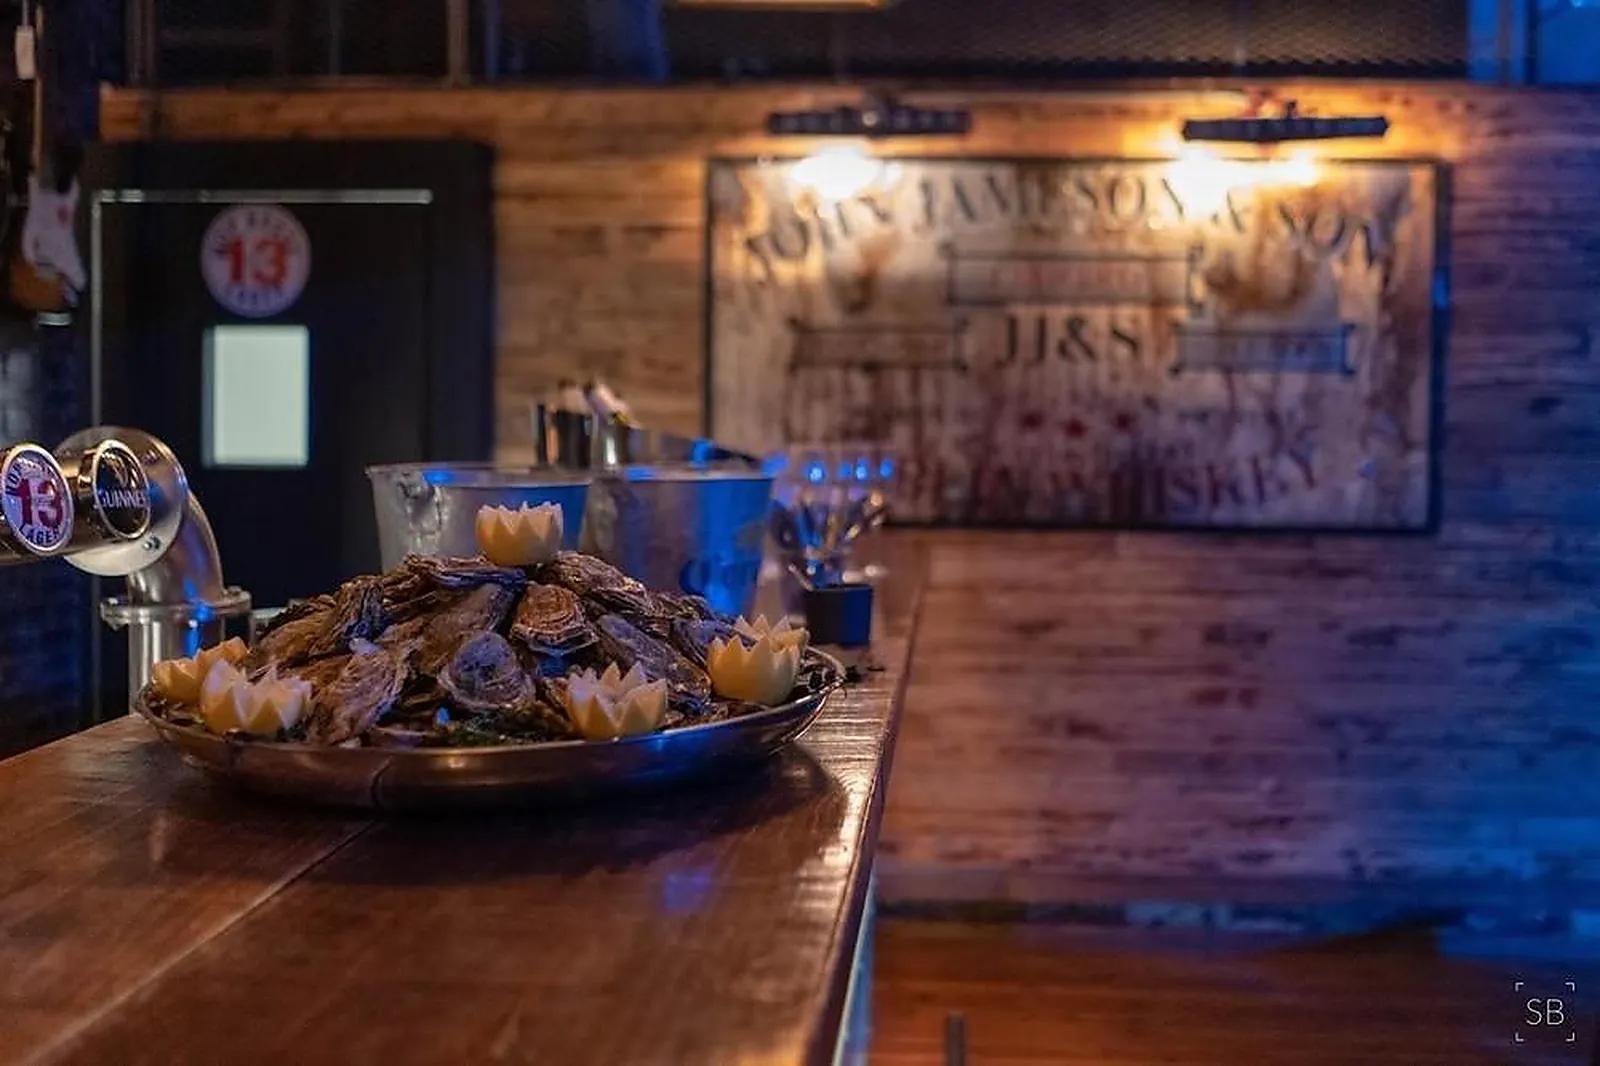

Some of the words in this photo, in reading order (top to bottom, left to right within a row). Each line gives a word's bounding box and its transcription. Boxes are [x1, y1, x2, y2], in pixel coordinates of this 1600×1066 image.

[912, 168, 1190, 233] JAMESON
[1274, 203, 1388, 268] SON
[229, 235, 287, 288] 13
[995, 314, 1142, 367] JJ&S
[14, 479, 64, 529] 13
[98, 487, 147, 509] GUINNE
[19, 522, 61, 547] LAGER
